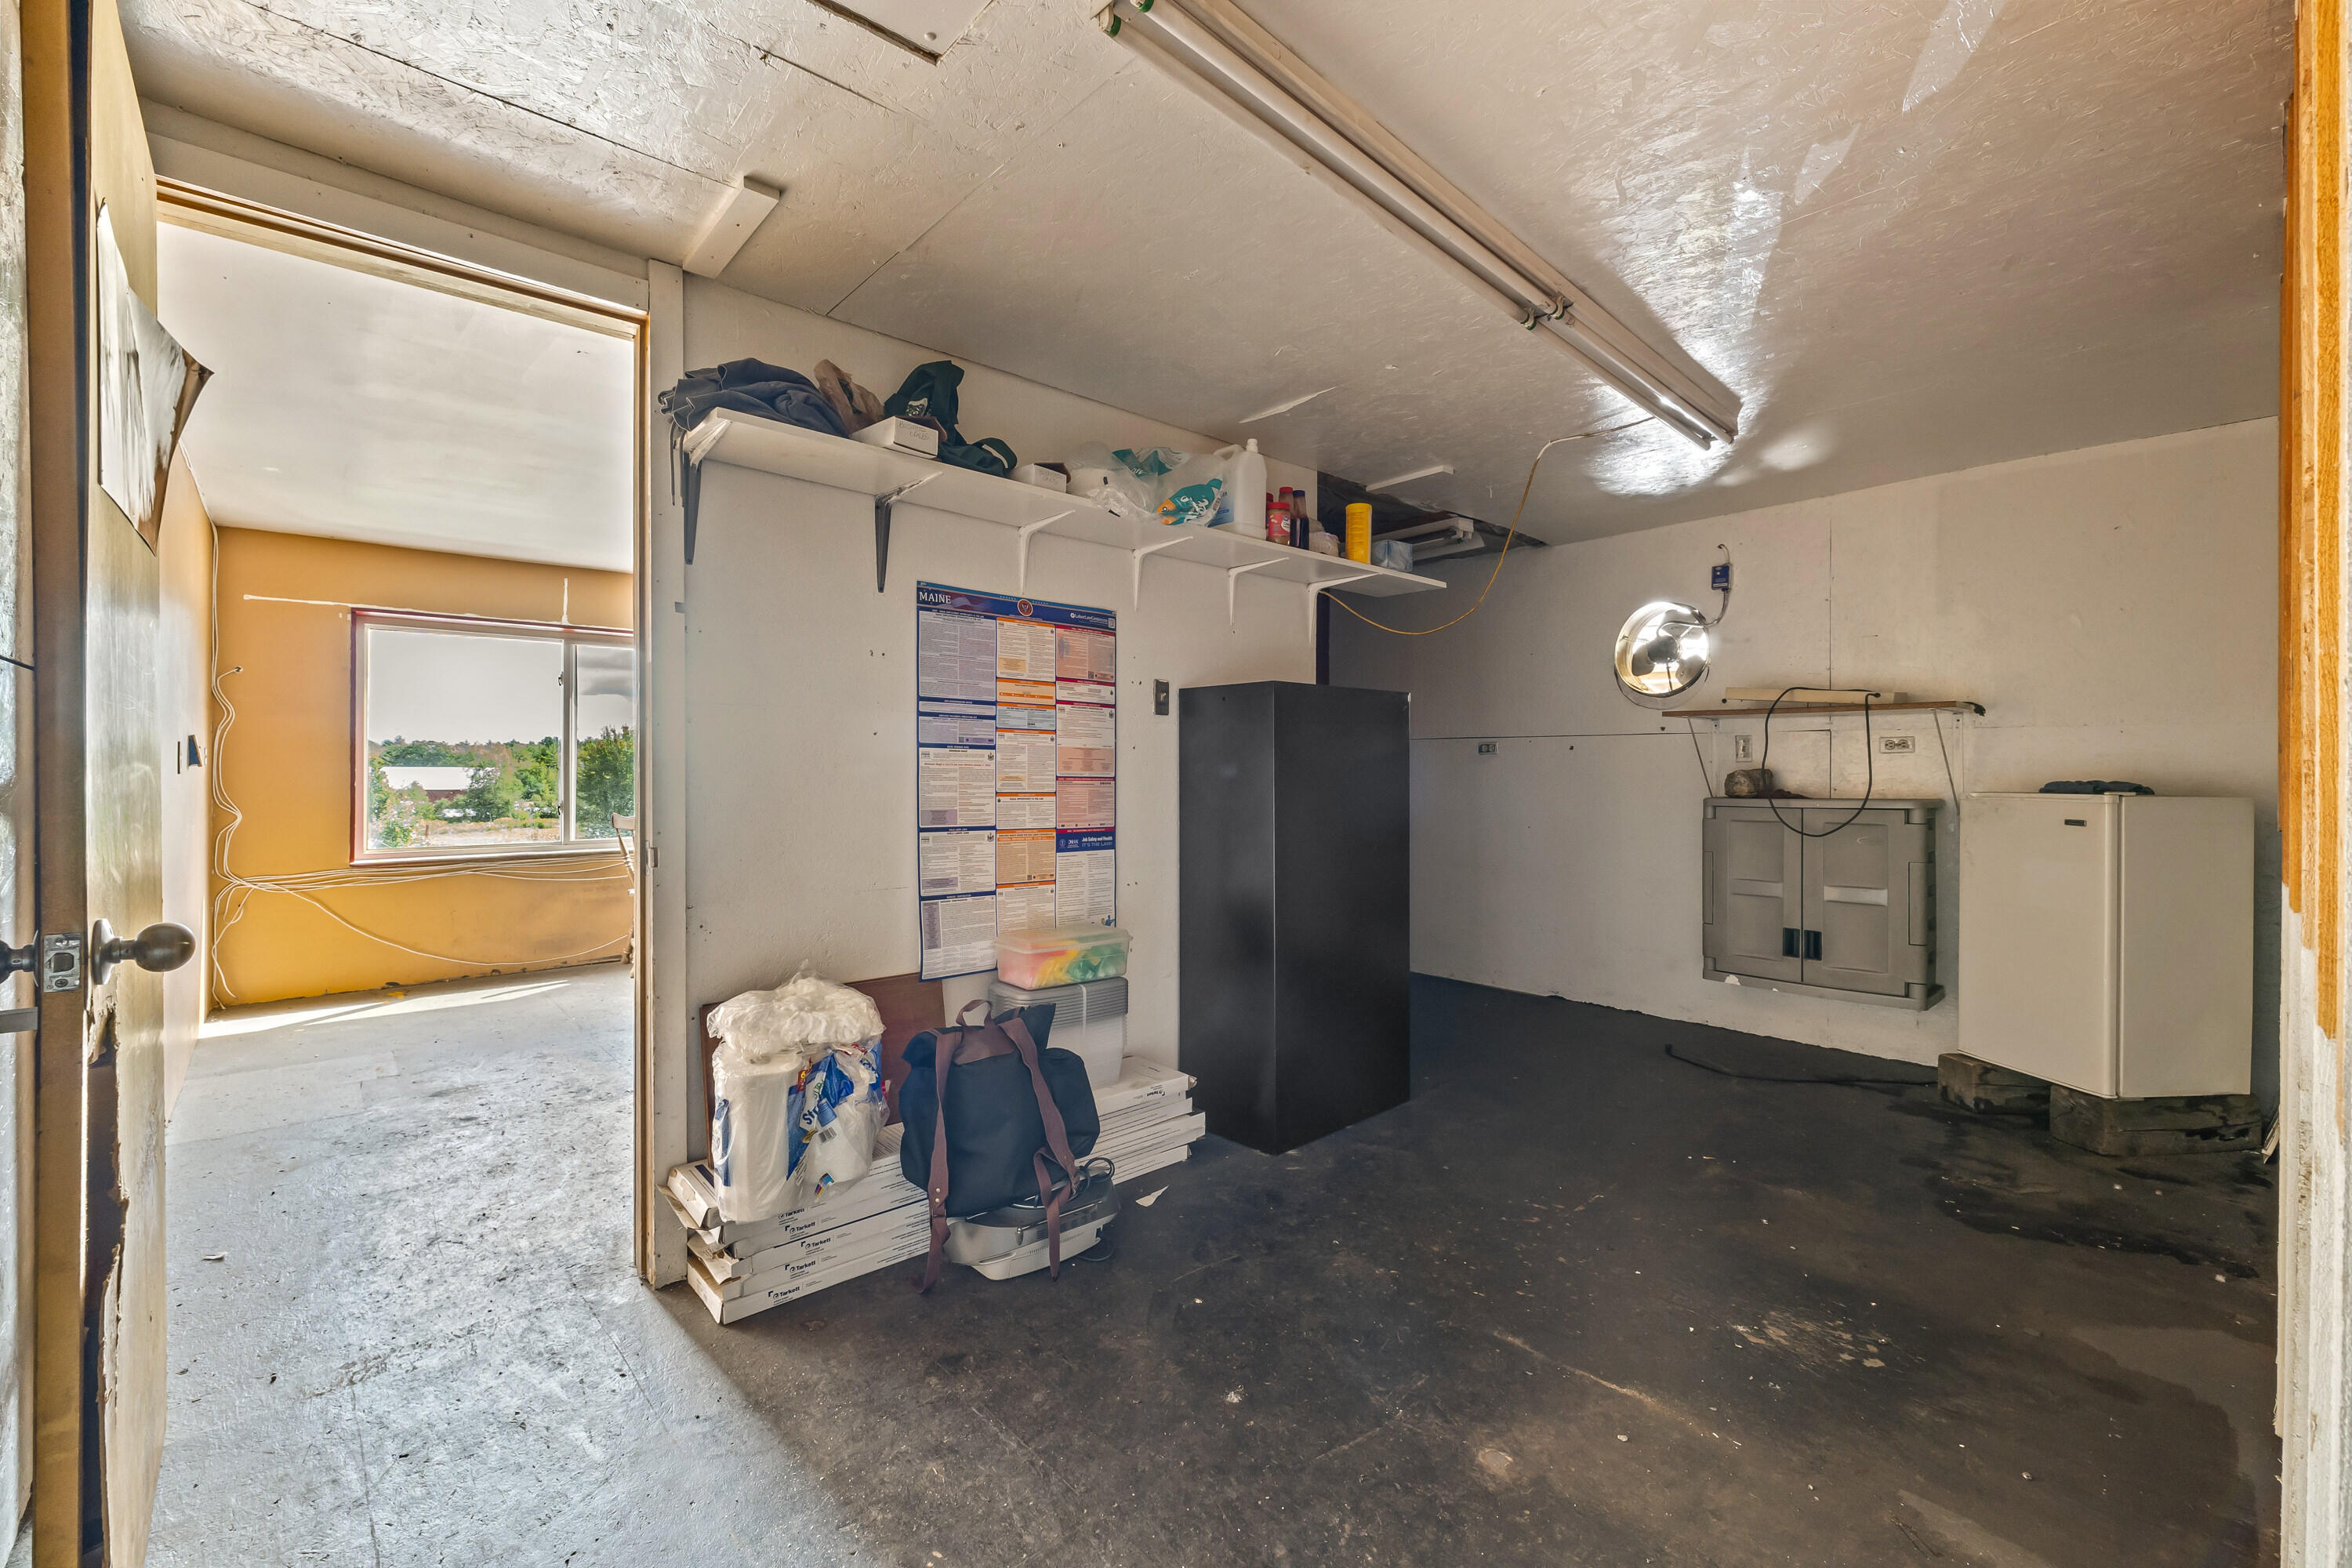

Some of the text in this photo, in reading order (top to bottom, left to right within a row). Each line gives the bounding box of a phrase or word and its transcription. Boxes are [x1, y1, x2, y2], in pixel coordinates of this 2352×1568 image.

[919, 591, 952, 604] MAINE
[785, 1208, 805, 1218] Tarkett
[796, 1221, 815, 1232] Tarkett
[811, 1237, 831, 1247] Tarkett
[796, 1260, 816, 1270] Tarkett
[779, 1287, 800, 1297] Tarkett
